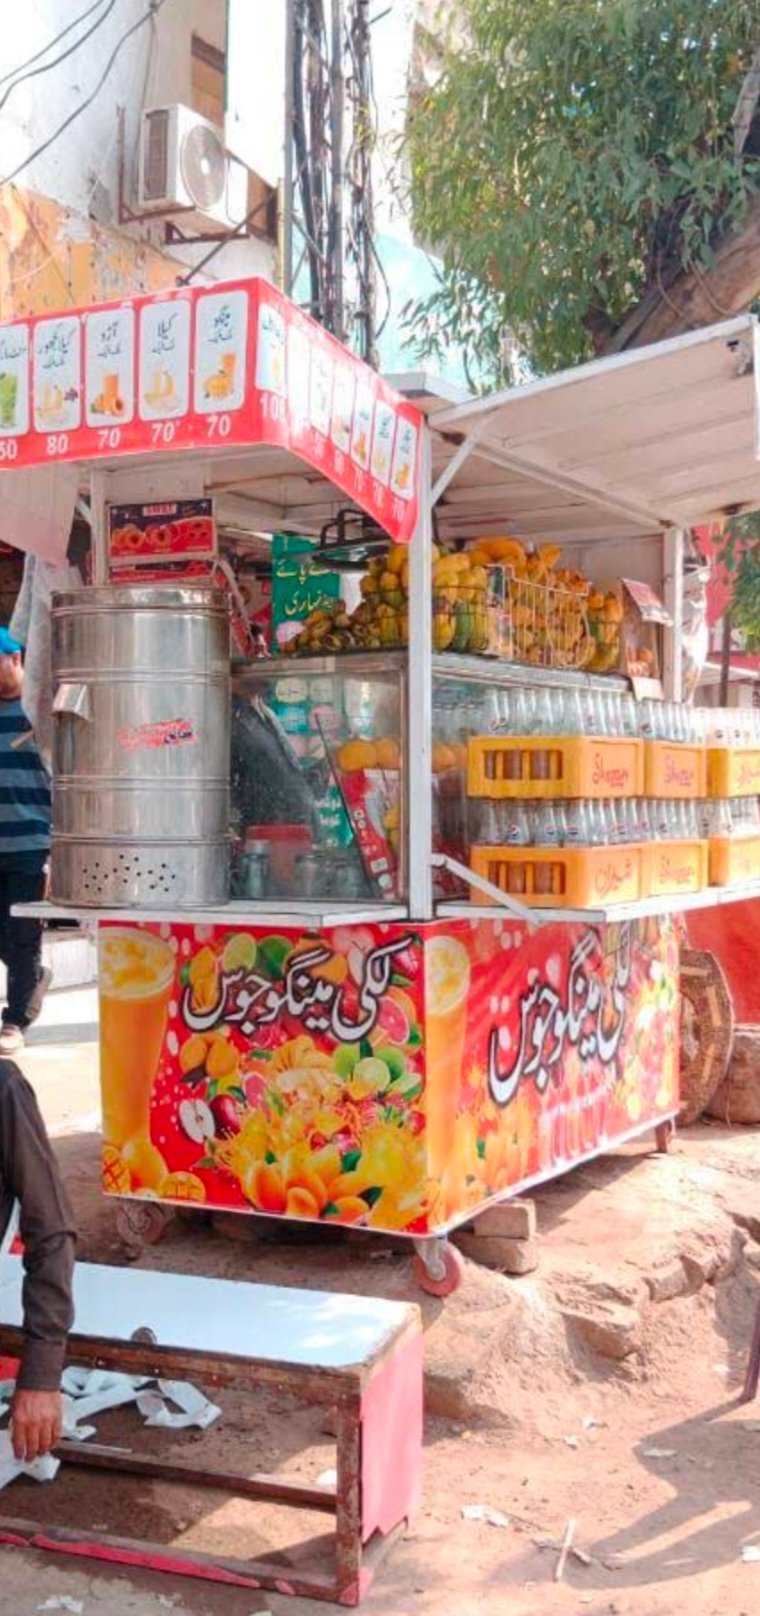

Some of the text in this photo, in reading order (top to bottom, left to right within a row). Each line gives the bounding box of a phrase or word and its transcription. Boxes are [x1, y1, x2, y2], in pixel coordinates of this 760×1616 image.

[97, 427, 122, 450] 70
[151, 422, 177, 444] 70
[205, 414, 232, 438] 70
[46, 433, 70, 455] 80
[284, 590, 323, 616] نہاری
[182, 931, 423, 1044] لکی مینگو جوس
[548, 926, 601, 1063] مینگو
[487, 977, 562, 1108] جوس
